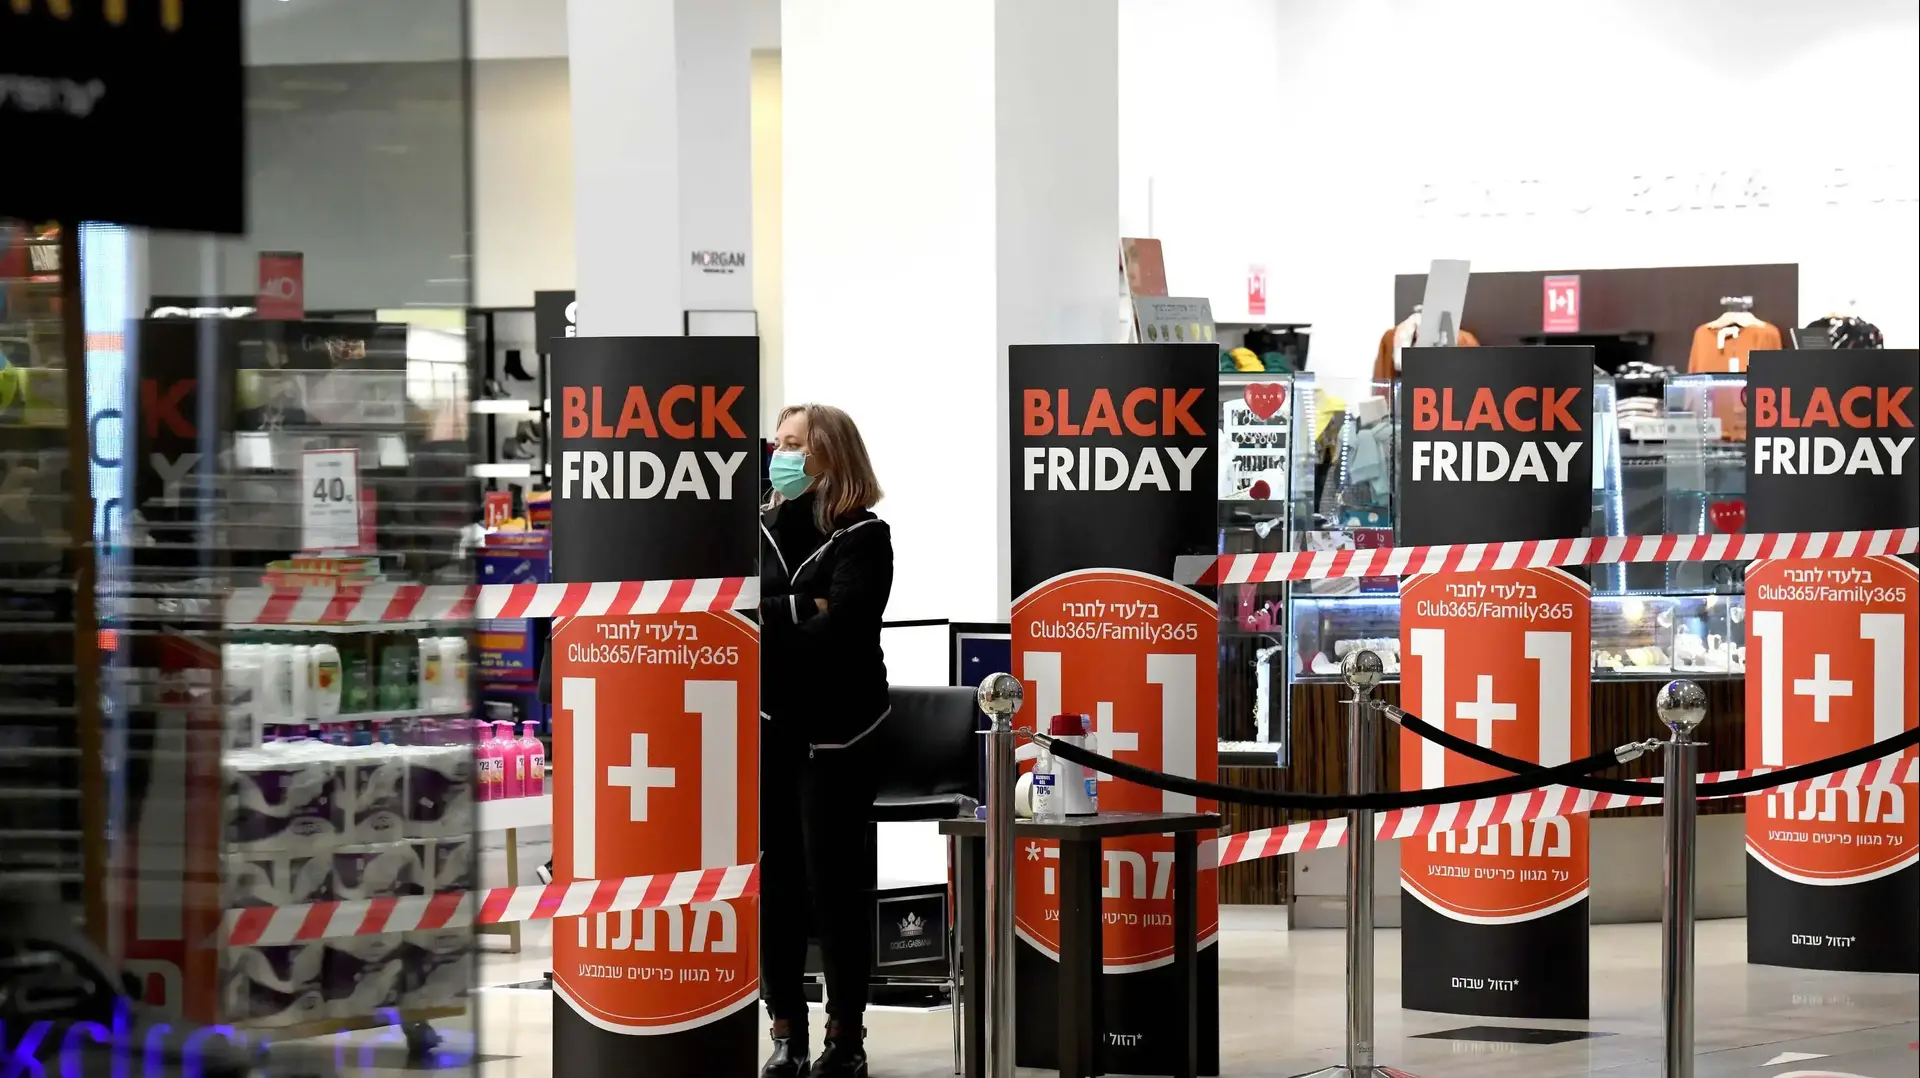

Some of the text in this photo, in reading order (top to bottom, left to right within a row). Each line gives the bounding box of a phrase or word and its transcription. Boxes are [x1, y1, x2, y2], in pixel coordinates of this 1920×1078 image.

[691, 251, 745, 267] MORGAN
[1548, 288, 1575, 316] 1+1
[562, 384, 746, 439] BLACK
[1023, 387, 1205, 437] BLACK
[1412, 386, 1582, 433] BLACK
[1755, 385, 1914, 429] BLACK
[1411, 440, 1584, 483] FRIDAY
[1754, 436, 1916, 476] FRIDAY
[561, 450, 748, 500] FRIDAY
[1023, 446, 1208, 492] FRIDAY
[1783, 566, 1873, 584] בלעדי לחברי
[1445, 580, 1537, 600] בלעדי לחברי
[1757, 583, 1906, 605] Club365/Family365
[1062, 599, 1159, 619] בלעדי לחברי
[1416, 600, 1573, 623] Club365/Family365
[597, 619, 698, 641] בלעדי לחברי
[1030, 620, 1198, 645] Club365/Family365
[568, 643, 738, 670] Club365/Family365
[1752, 610, 1905, 767] 1+1
[1410, 628, 1572, 791] 1+1
[562, 677, 738, 879] 1+1
[1036, 786, 1050, 795] 70%
[1768, 830, 1903, 847] על מגוון פריטים שבמבצע
[1427, 864, 1569, 883] על מגוון פריטים שבמבצע
[1102, 912, 1172, 928] מגוון פריטי
[1791, 933, 1823, 946] שבהם
[578, 963, 735, 983] על מגוון פריטים שבמבצע
[1451, 976, 1484, 990] שבהם
